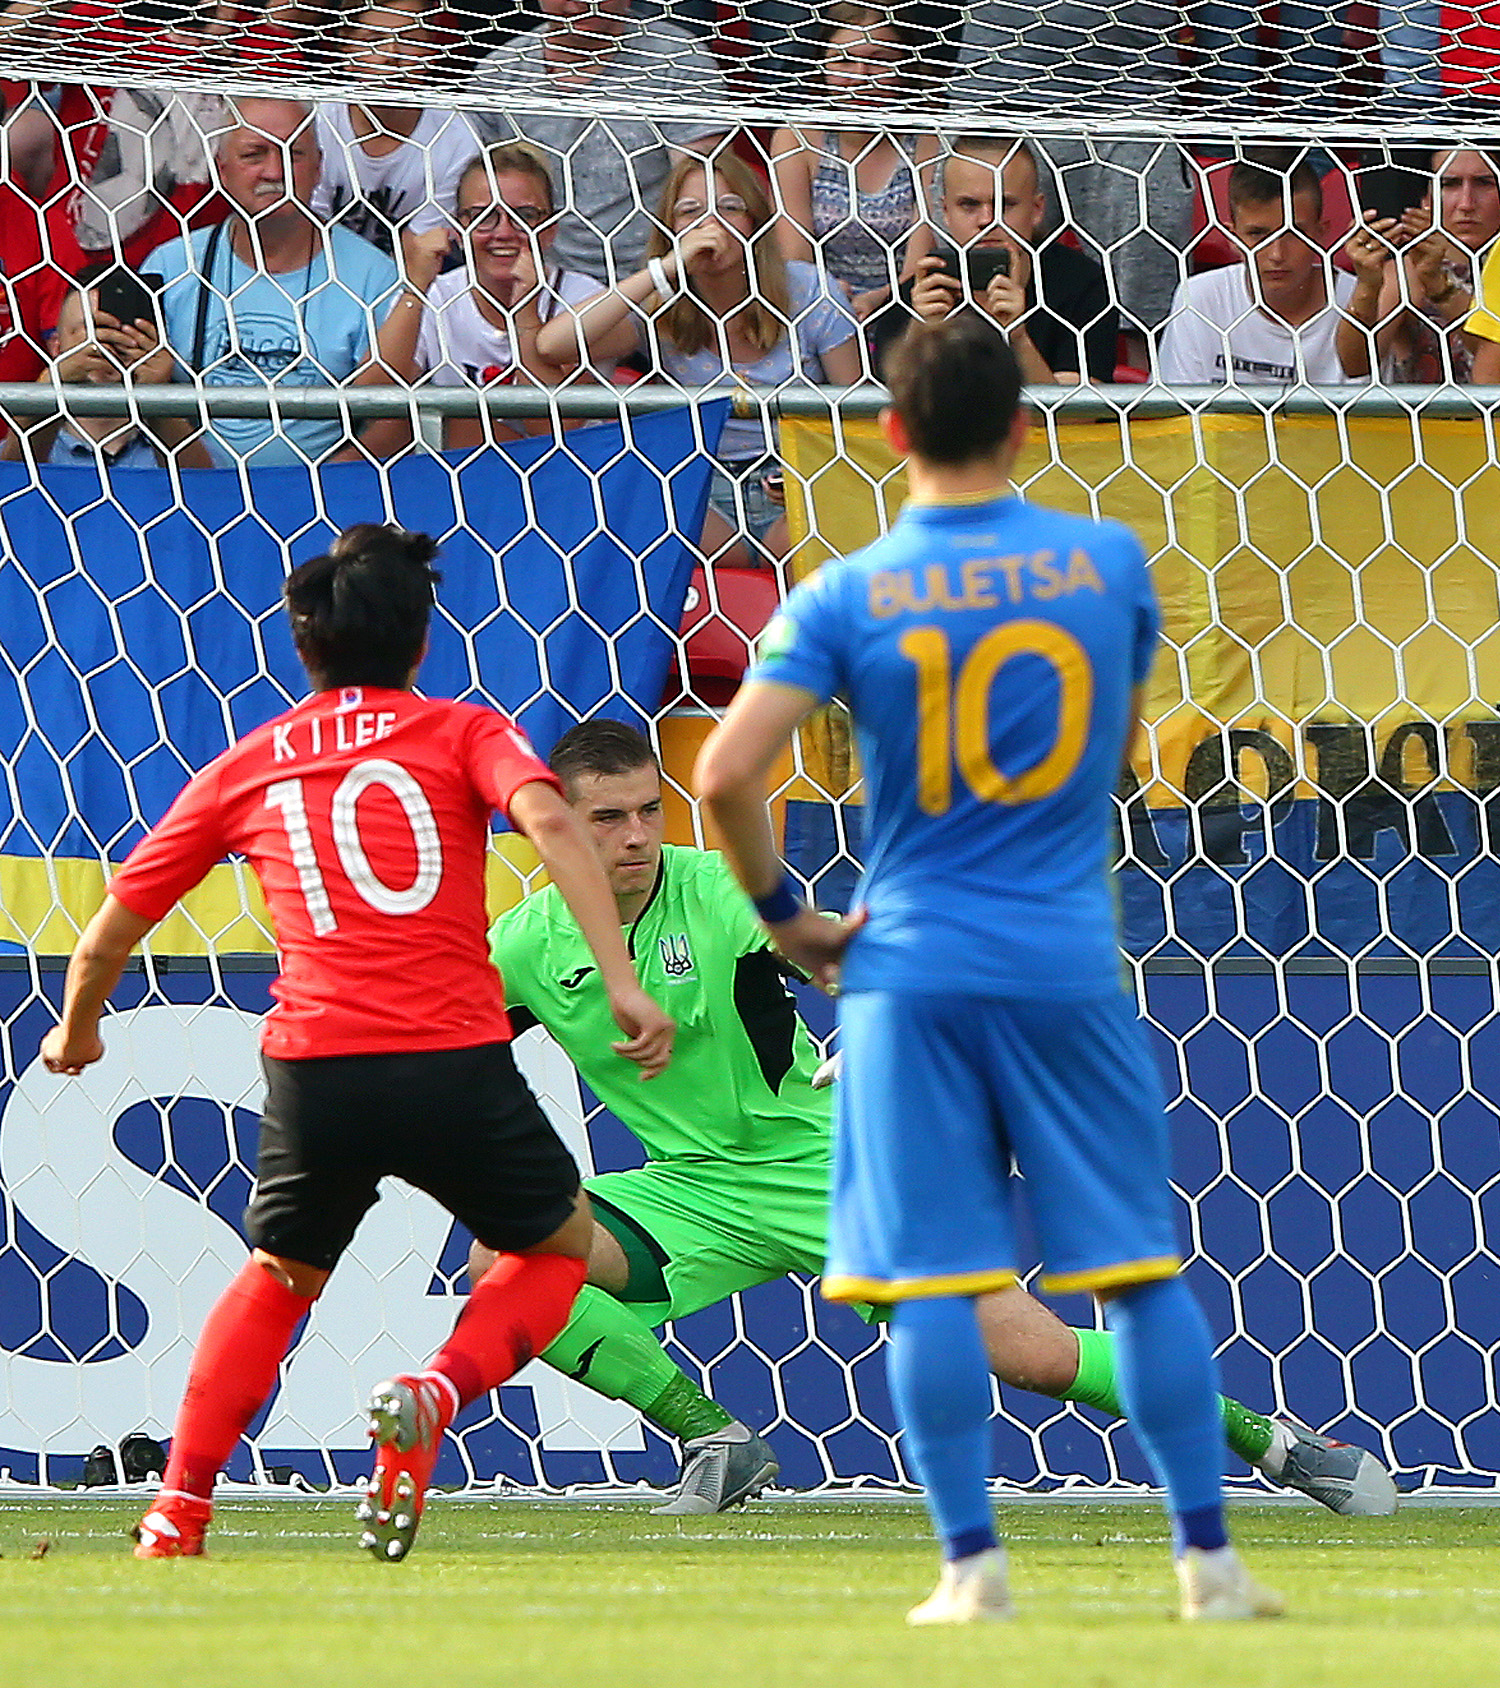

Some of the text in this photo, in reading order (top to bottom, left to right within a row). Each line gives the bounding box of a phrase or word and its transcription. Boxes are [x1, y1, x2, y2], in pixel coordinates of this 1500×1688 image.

[869, 549, 1105, 620] BULETSA
[273, 721, 297, 763] K
[310, 716, 323, 755] I
[900, 618, 1095, 818] 10
[264, 758, 445, 938] 10
